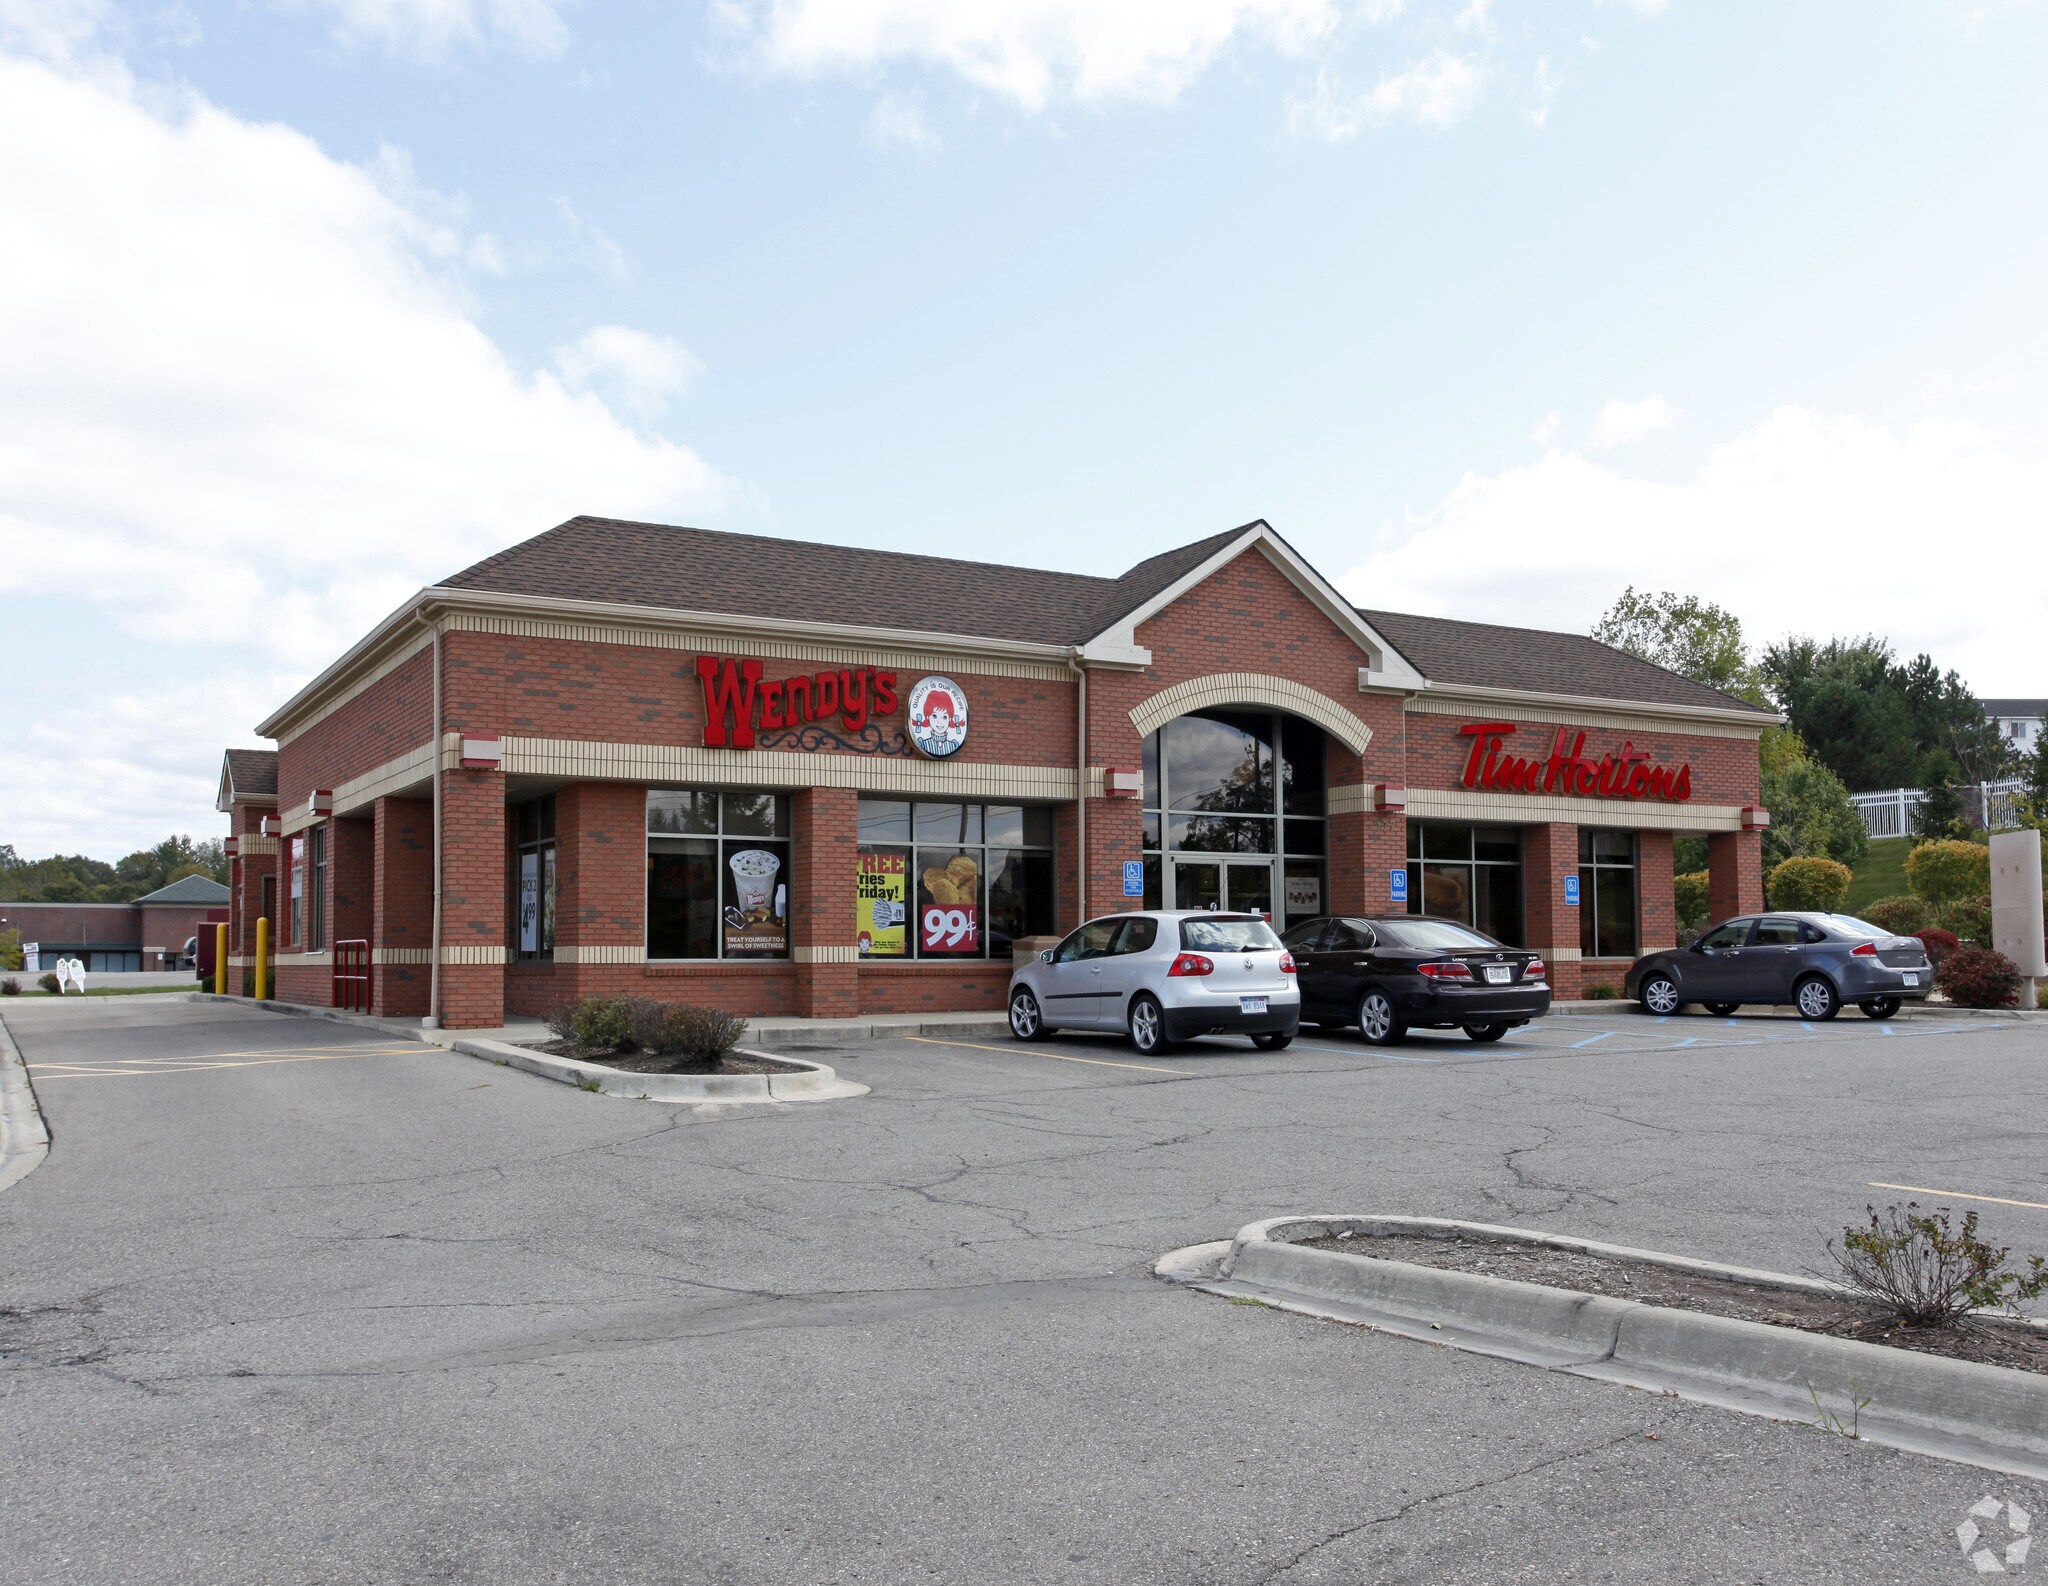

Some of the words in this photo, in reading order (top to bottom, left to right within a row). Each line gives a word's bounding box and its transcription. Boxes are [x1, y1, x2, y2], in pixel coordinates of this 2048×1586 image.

[696, 655, 899, 749] Wendy's
[912, 685, 929, 709] QUALITY
[938, 682, 951, 691] OUR
[951, 690, 964, 711] RECIPE
[1458, 723, 1540, 791] Tim
[1543, 725, 1691, 800] Hortons
[522, 880, 532, 893] PICK
[857, 871, 886, 886] ries
[857, 885, 899, 902] riday!
[924, 909, 977, 947] 99¢
